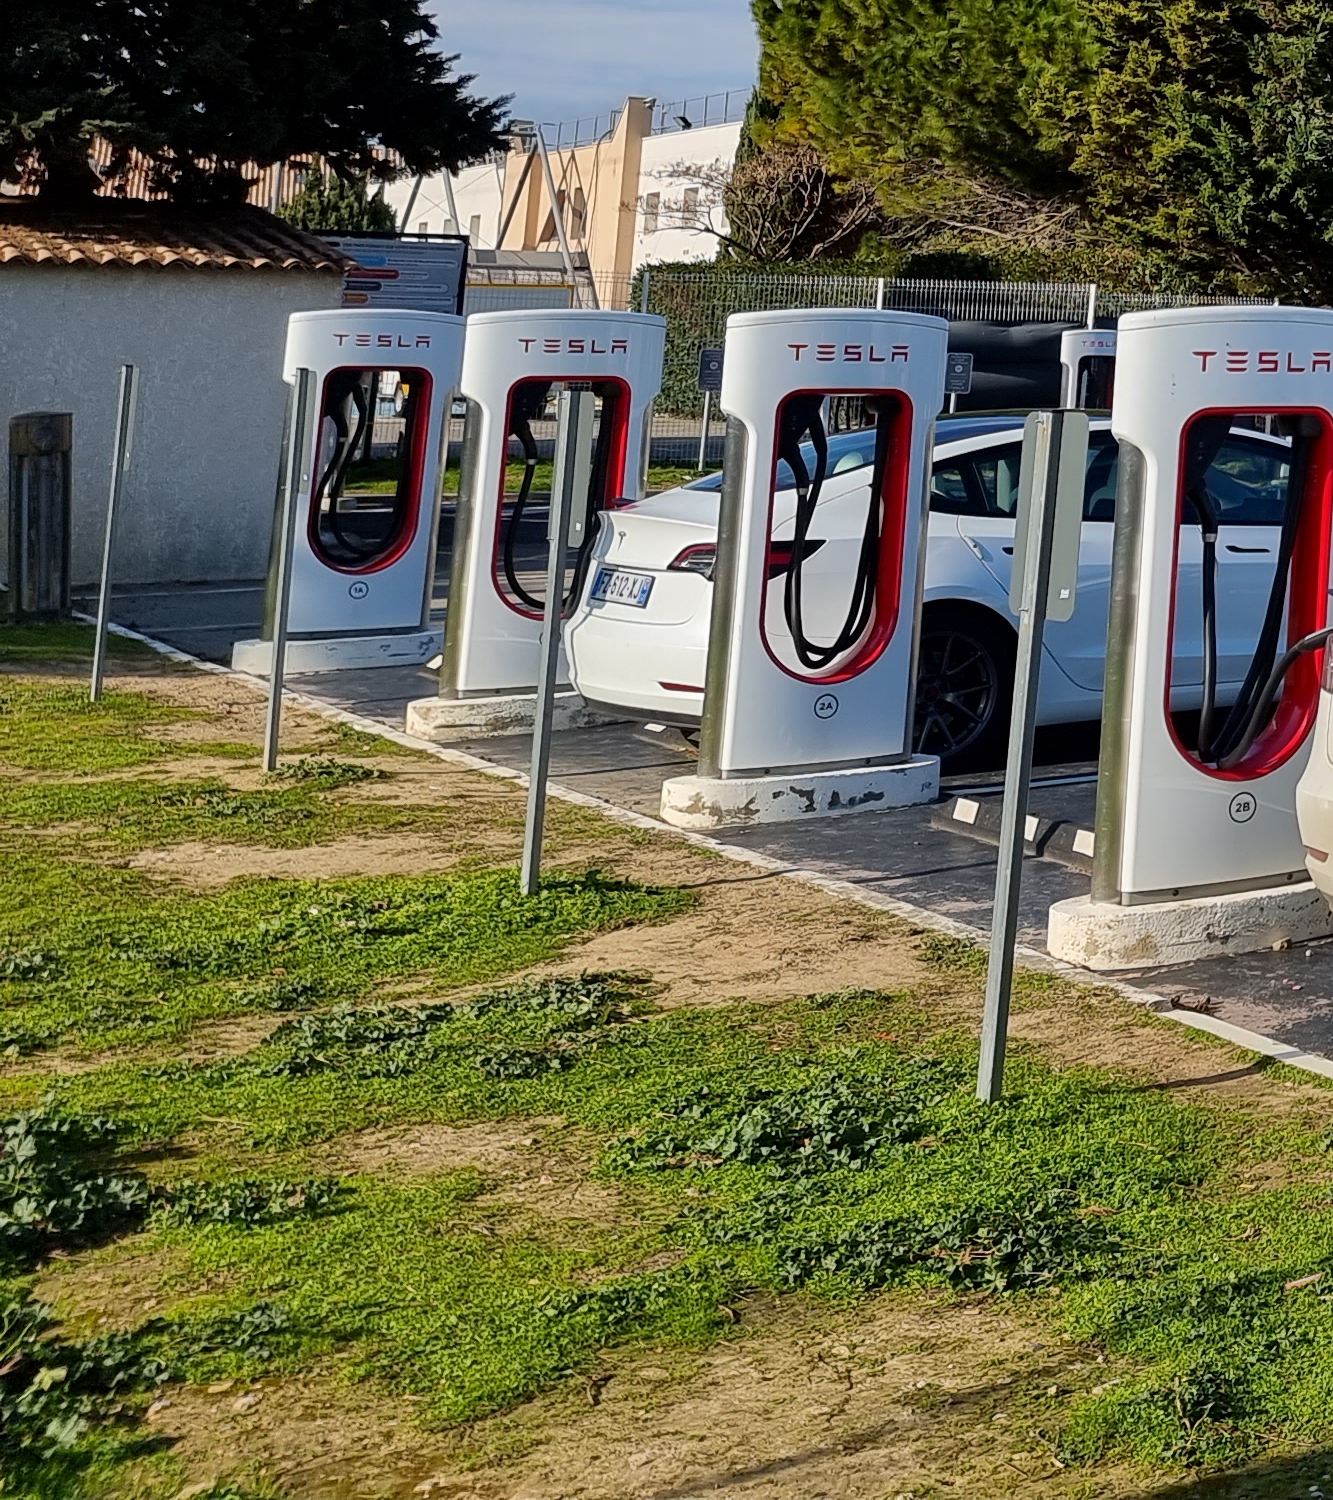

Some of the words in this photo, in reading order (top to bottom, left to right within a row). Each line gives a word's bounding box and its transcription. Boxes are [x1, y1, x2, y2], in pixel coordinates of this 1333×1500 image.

[332, 333, 431, 349] TESLA
[518, 338, 628, 354] TESLA
[787, 344, 910, 363] TESLA
[1192, 351, 1332, 373] TESLA
[818, 702, 833, 711] 2A
[1235, 801, 1251, 813] 2B
